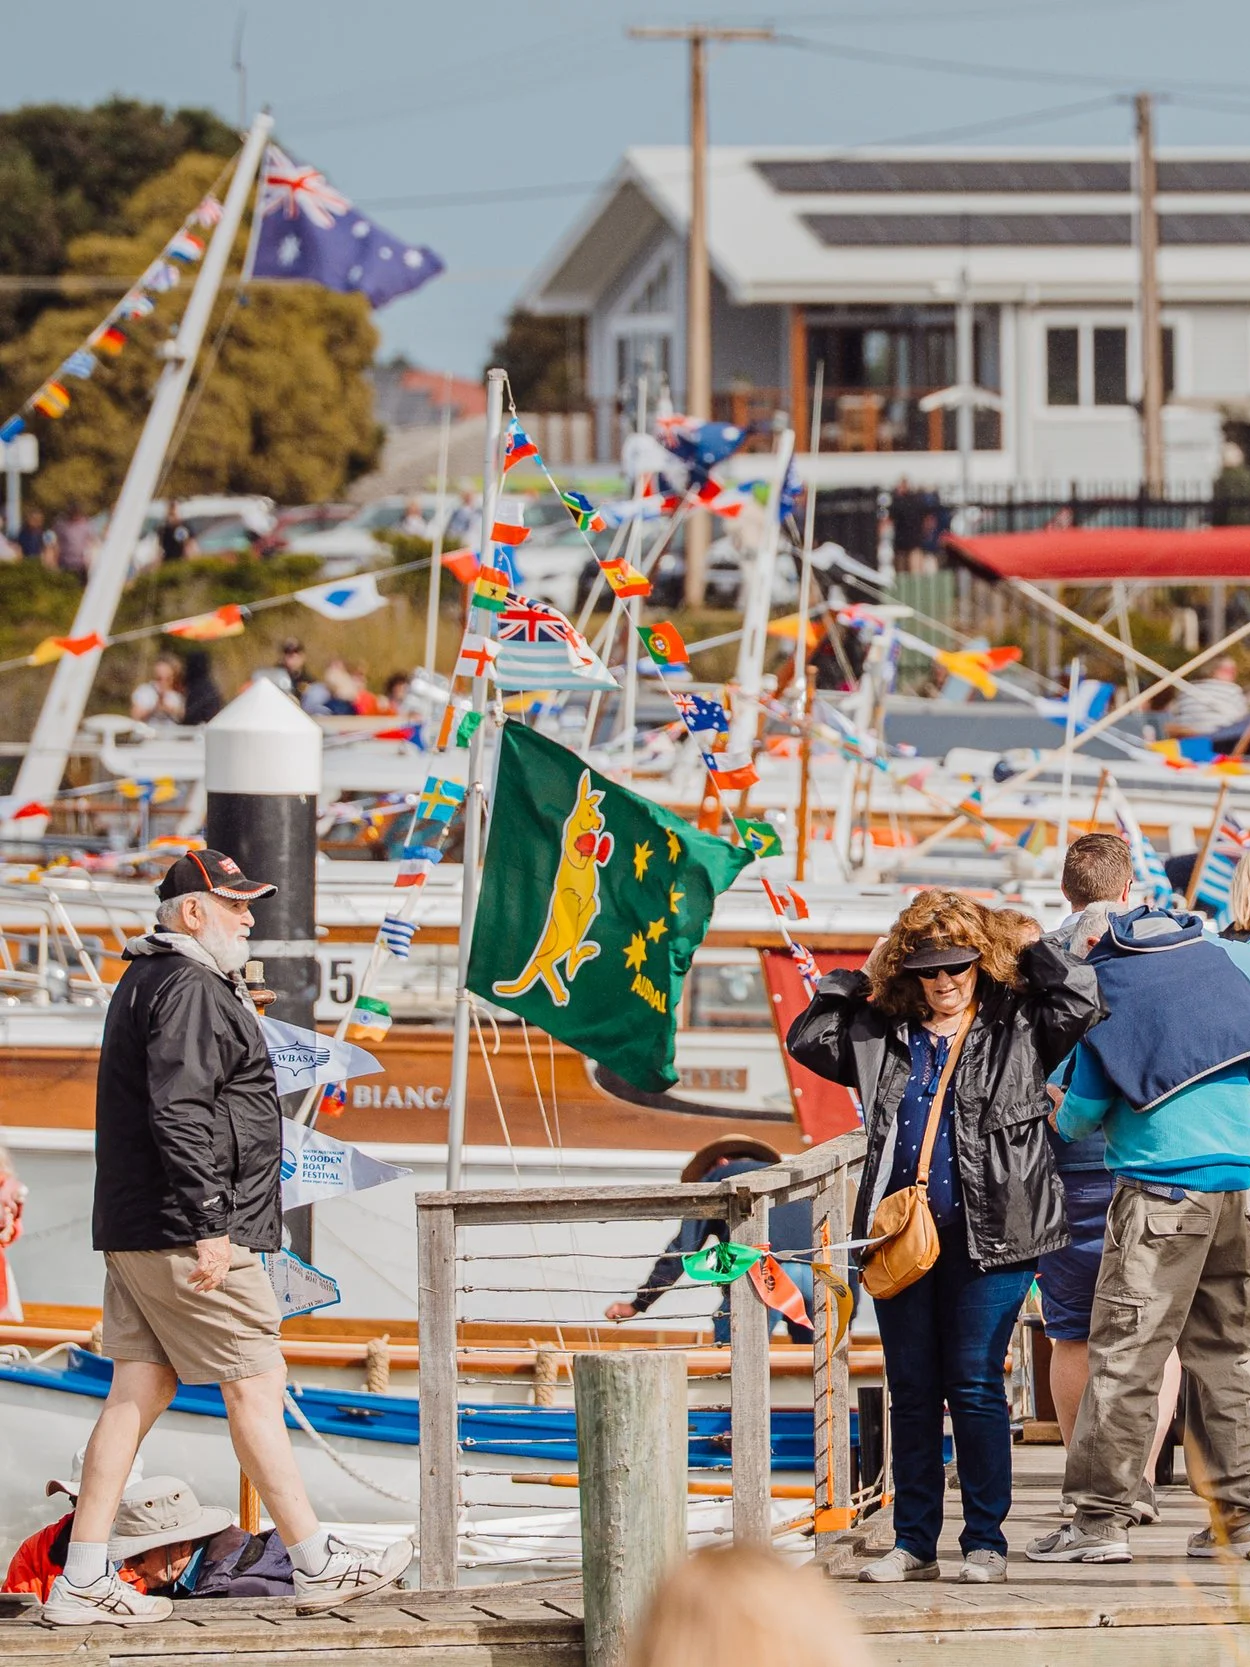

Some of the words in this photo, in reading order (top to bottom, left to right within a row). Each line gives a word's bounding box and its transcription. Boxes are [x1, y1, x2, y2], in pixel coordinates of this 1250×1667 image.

[277, 1054, 315, 1063] WBASA
[302, 1155, 342, 1164] WOODEN
[302, 1163, 326, 1171] BOAT
[302, 1171, 341, 1180] FESTIVAL
